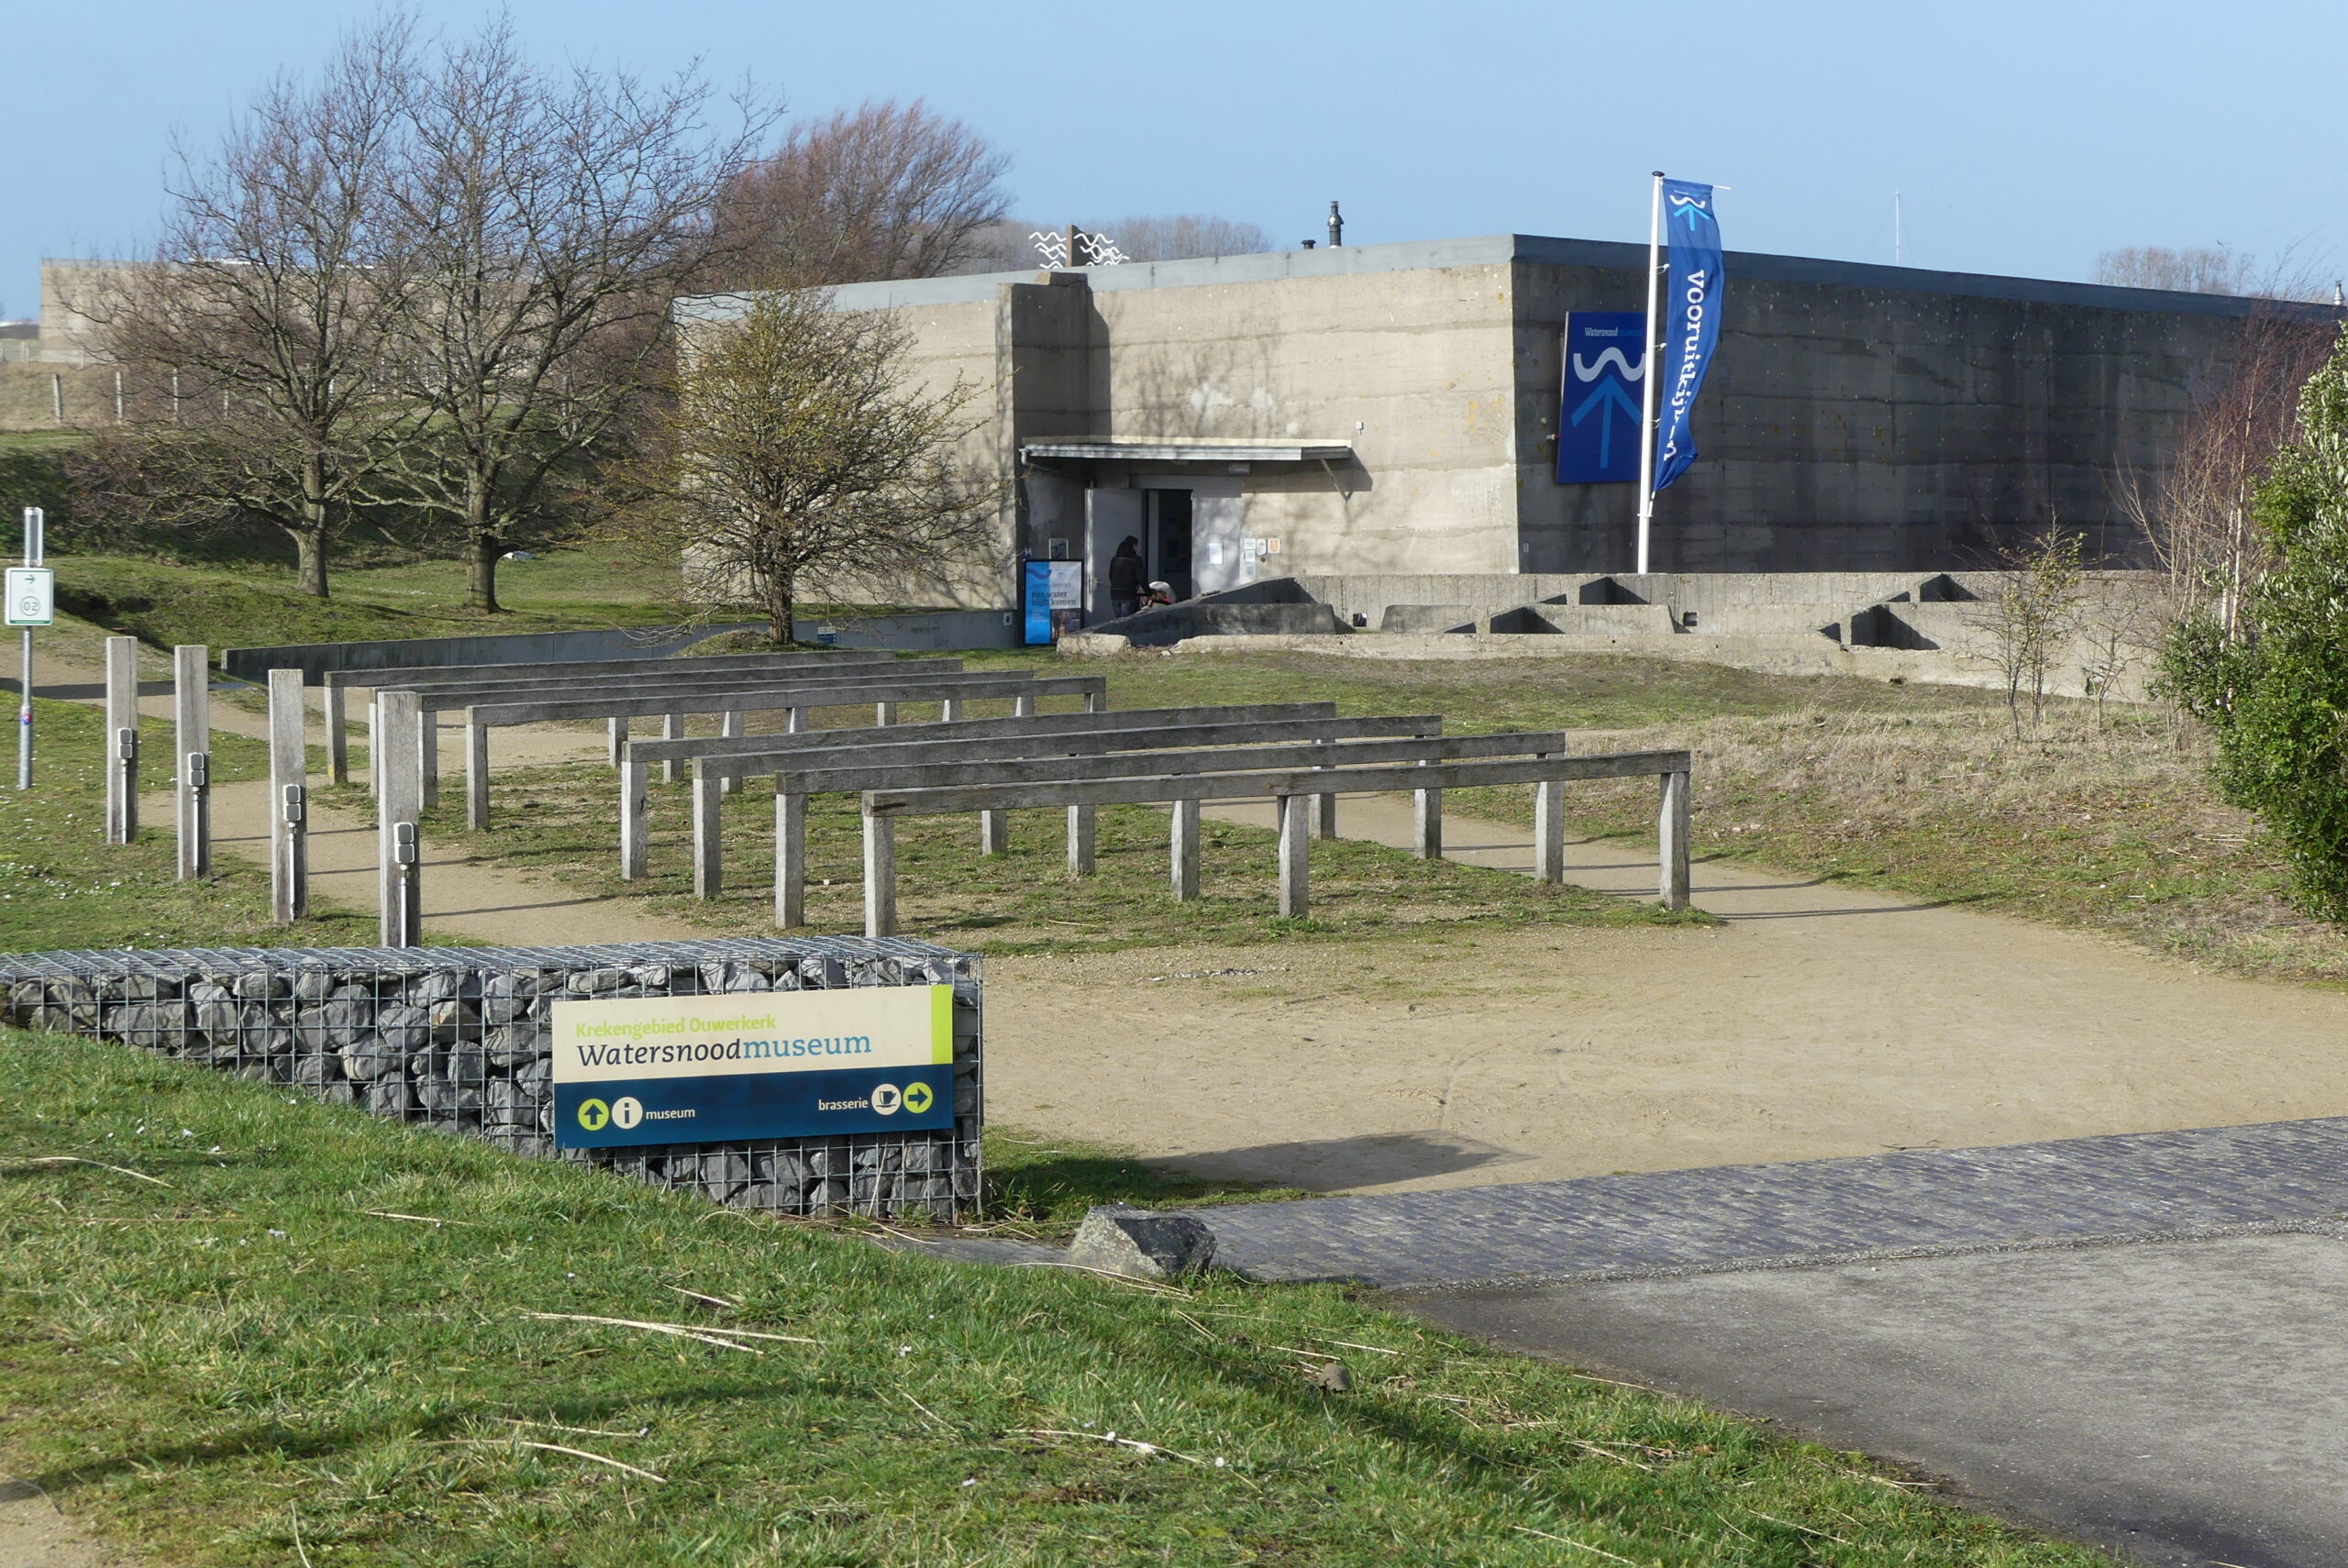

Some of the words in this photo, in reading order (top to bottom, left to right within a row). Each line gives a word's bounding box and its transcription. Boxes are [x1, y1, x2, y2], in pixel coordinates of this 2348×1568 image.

[1663, 270, 1705, 461] vooruitkijn
[24, 602, 39, 612] 02
[576, 1017, 685, 1041] Krekengebied
[690, 1013, 776, 1032] Ouwerkerk
[577, 1035, 871, 1066] Watersnoodmuseum
[818, 1097, 869, 1110] brasserie
[646, 1109, 695, 1120] museum
